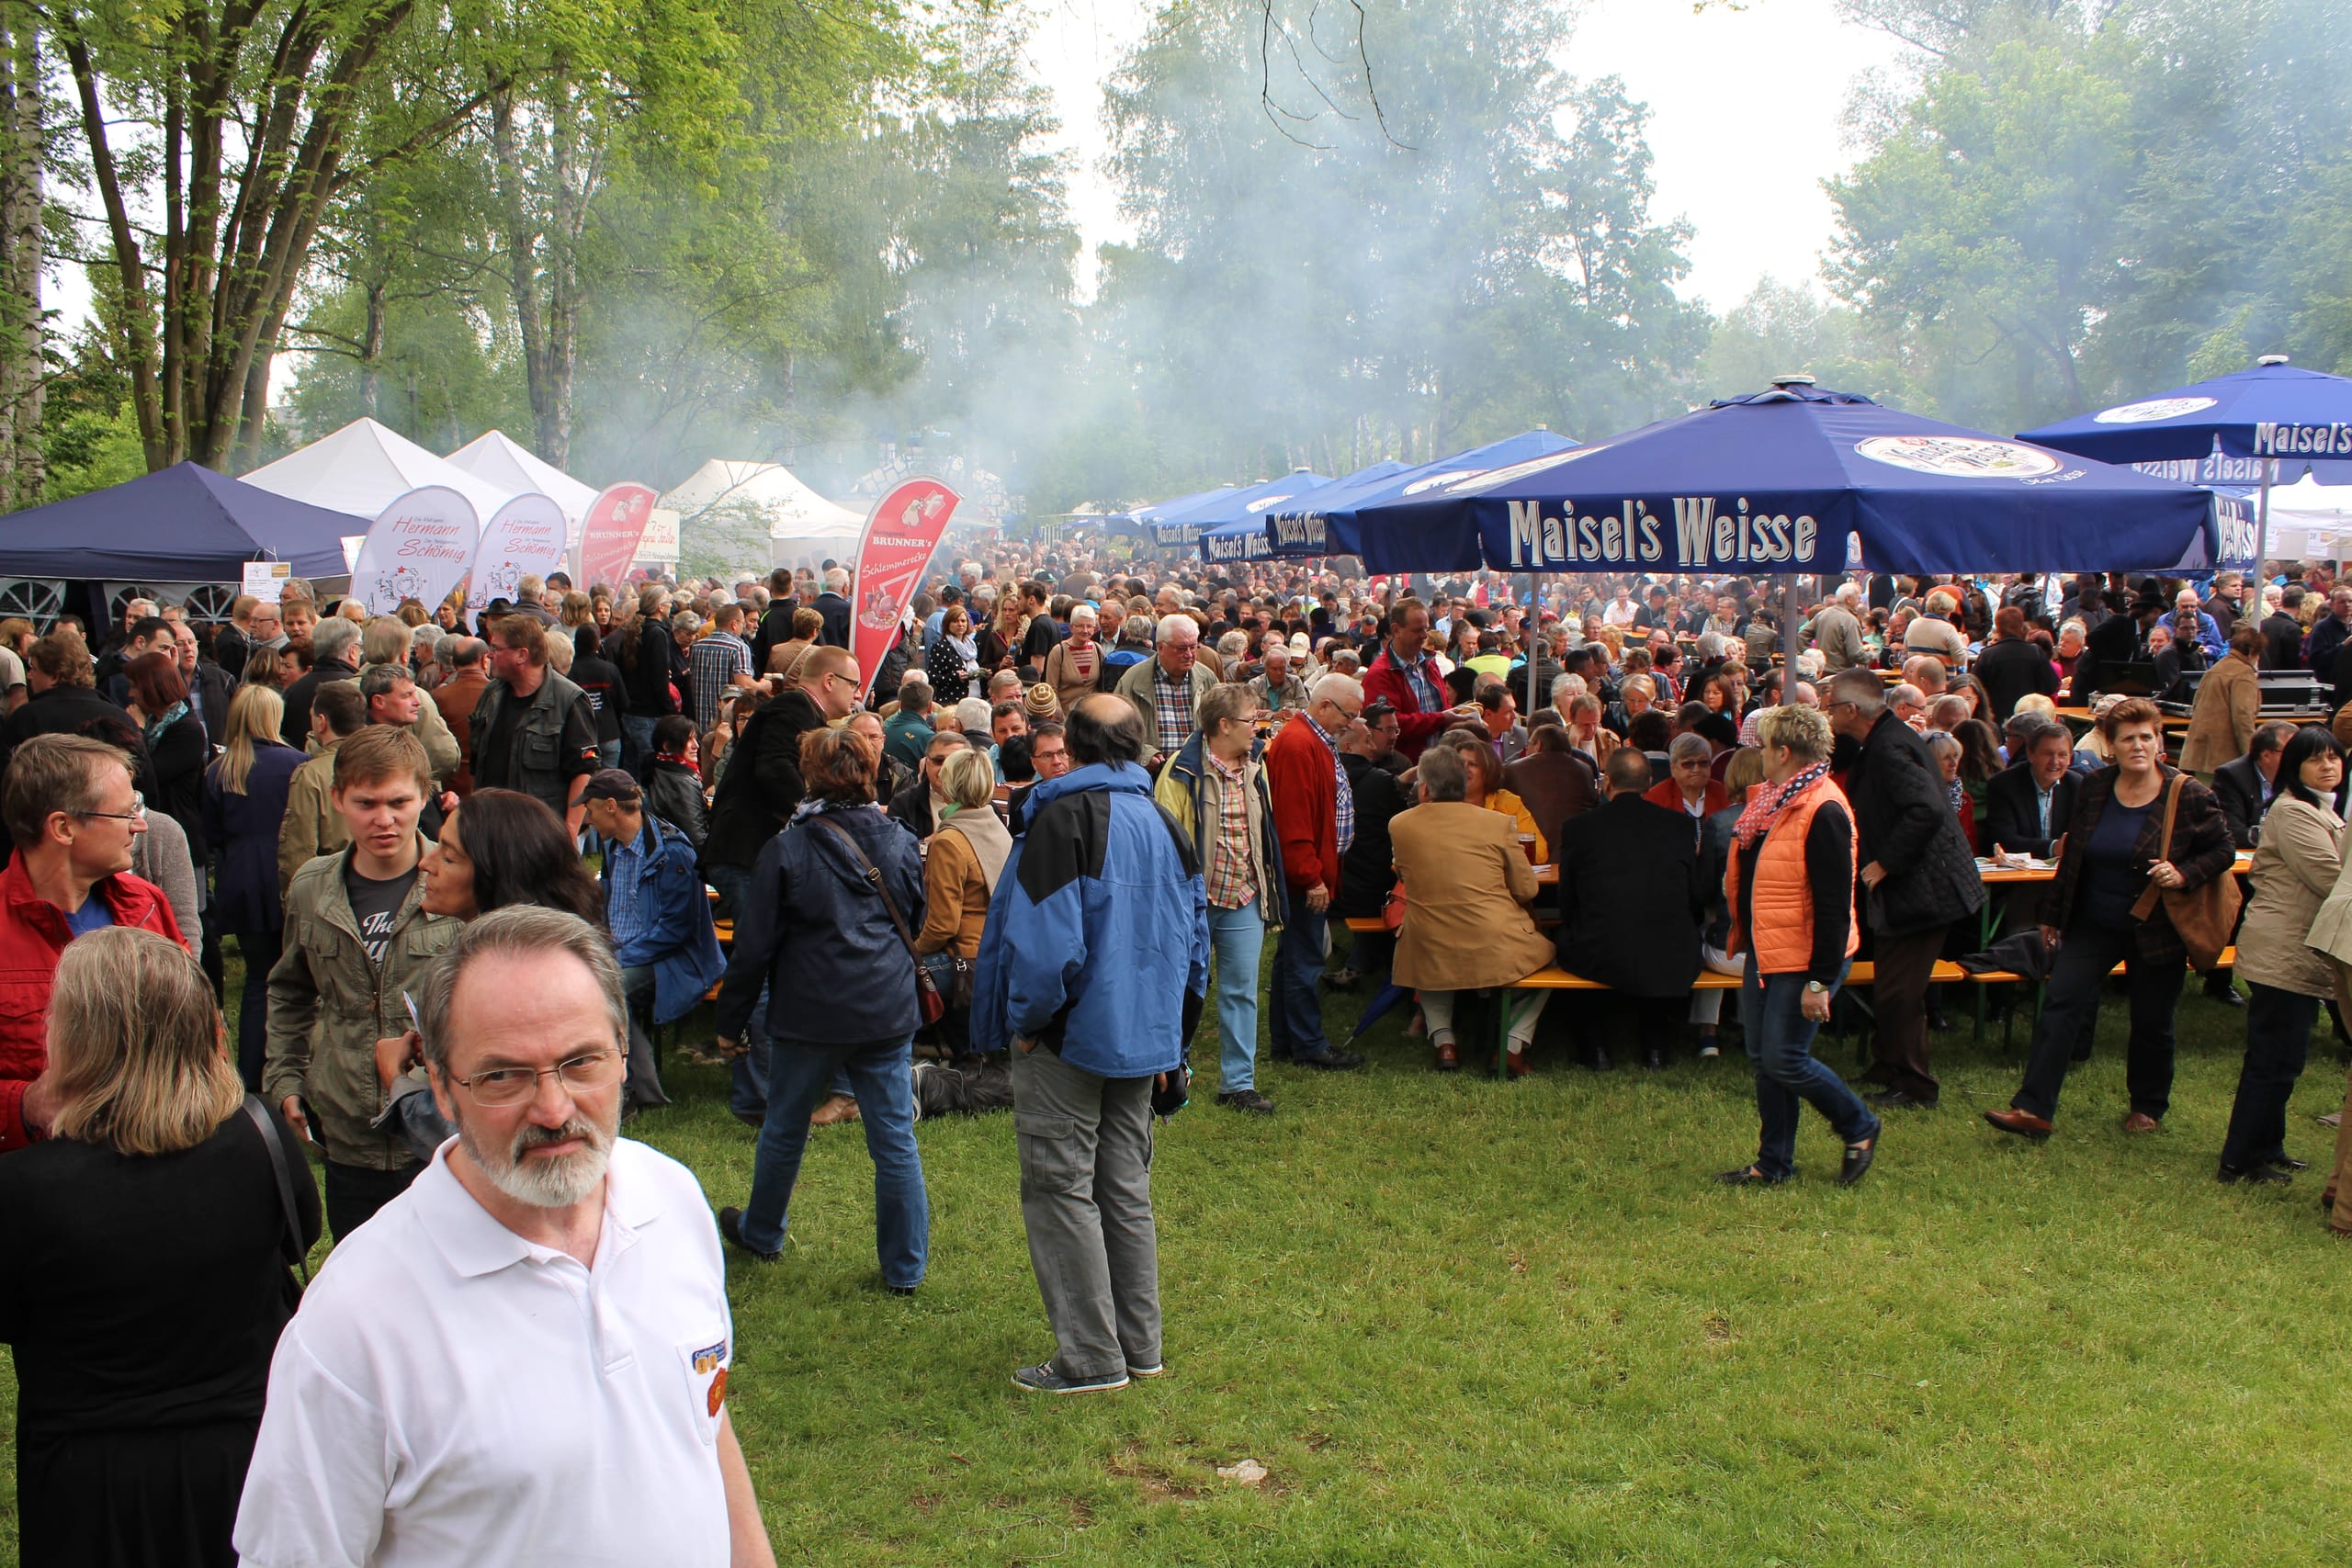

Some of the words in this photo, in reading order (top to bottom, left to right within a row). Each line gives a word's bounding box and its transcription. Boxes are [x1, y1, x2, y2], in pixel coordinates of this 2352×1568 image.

[2254, 422, 2352, 455] Maisel's
[391, 516, 460, 536] Hermann
[501, 518, 552, 536] Hermann
[1507, 499, 1663, 567] Maisel's
[1672, 496, 1817, 567] Weisse
[397, 538, 466, 564] Schömig
[503, 537, 557, 559] Schömig
[872, 536, 933, 548] BRUNNER's
[1208, 534, 1243, 561] Maisel's
[1244, 531, 1273, 558] Weiss
[861, 551, 928, 579] Schlemmerecke
[362, 910, 397, 936] The
